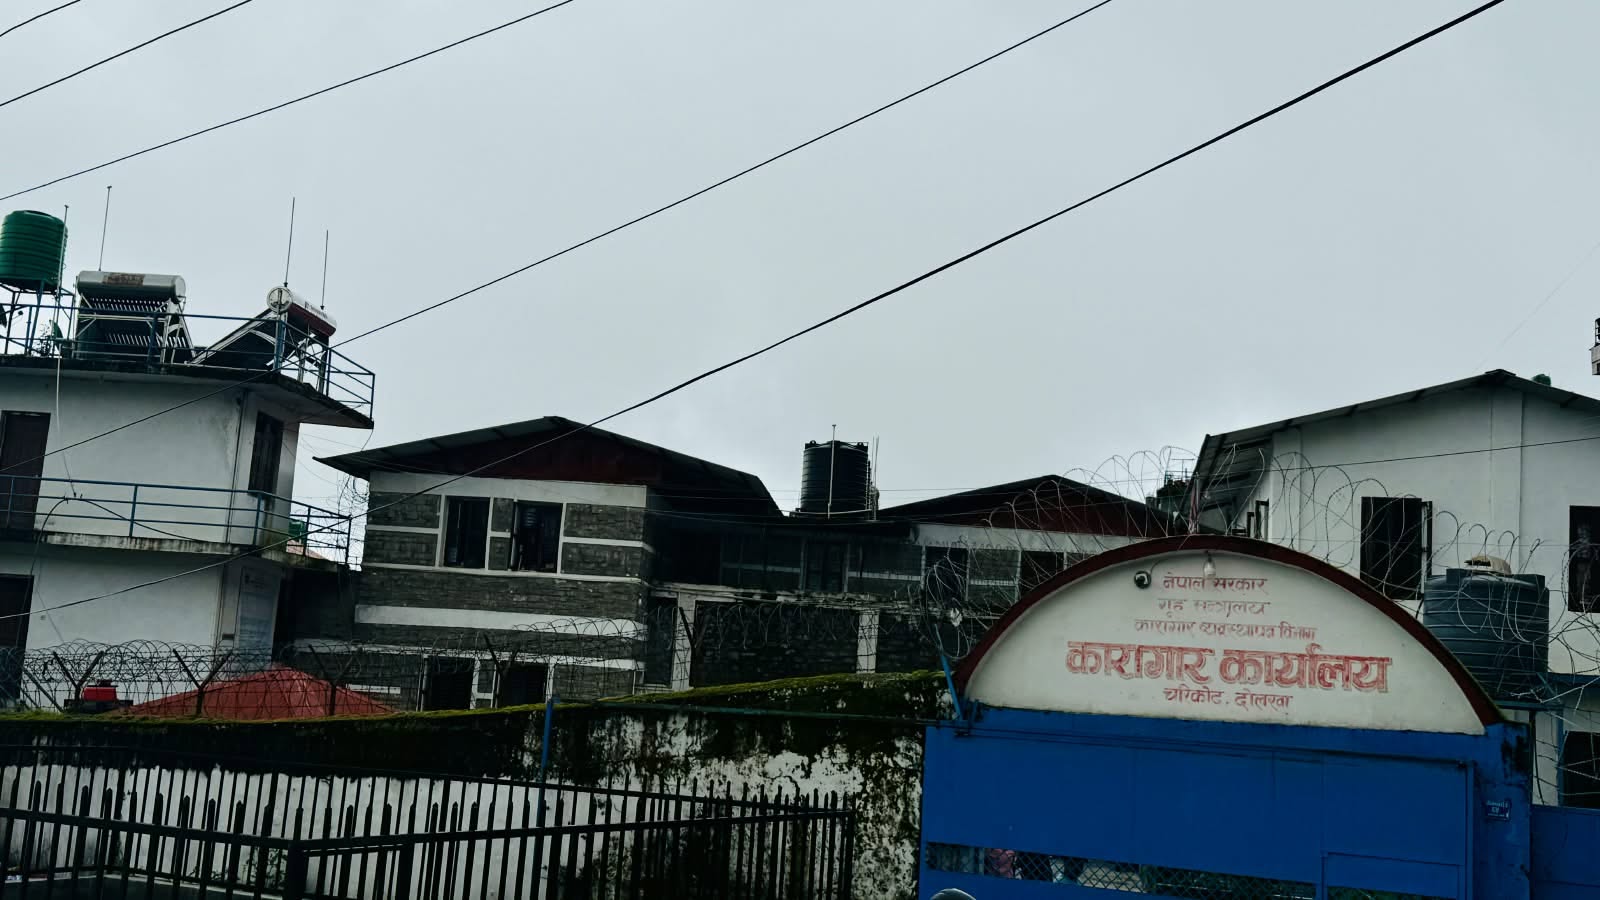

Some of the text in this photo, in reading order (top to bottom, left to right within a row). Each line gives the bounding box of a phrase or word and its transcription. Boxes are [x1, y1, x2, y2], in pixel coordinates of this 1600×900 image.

[1163, 574, 1269, 593] नेपाल सरकार
[1066, 641, 1393, 693] कारागार कार्यालय
[1234, 688, 1294, 710] दोलखा
